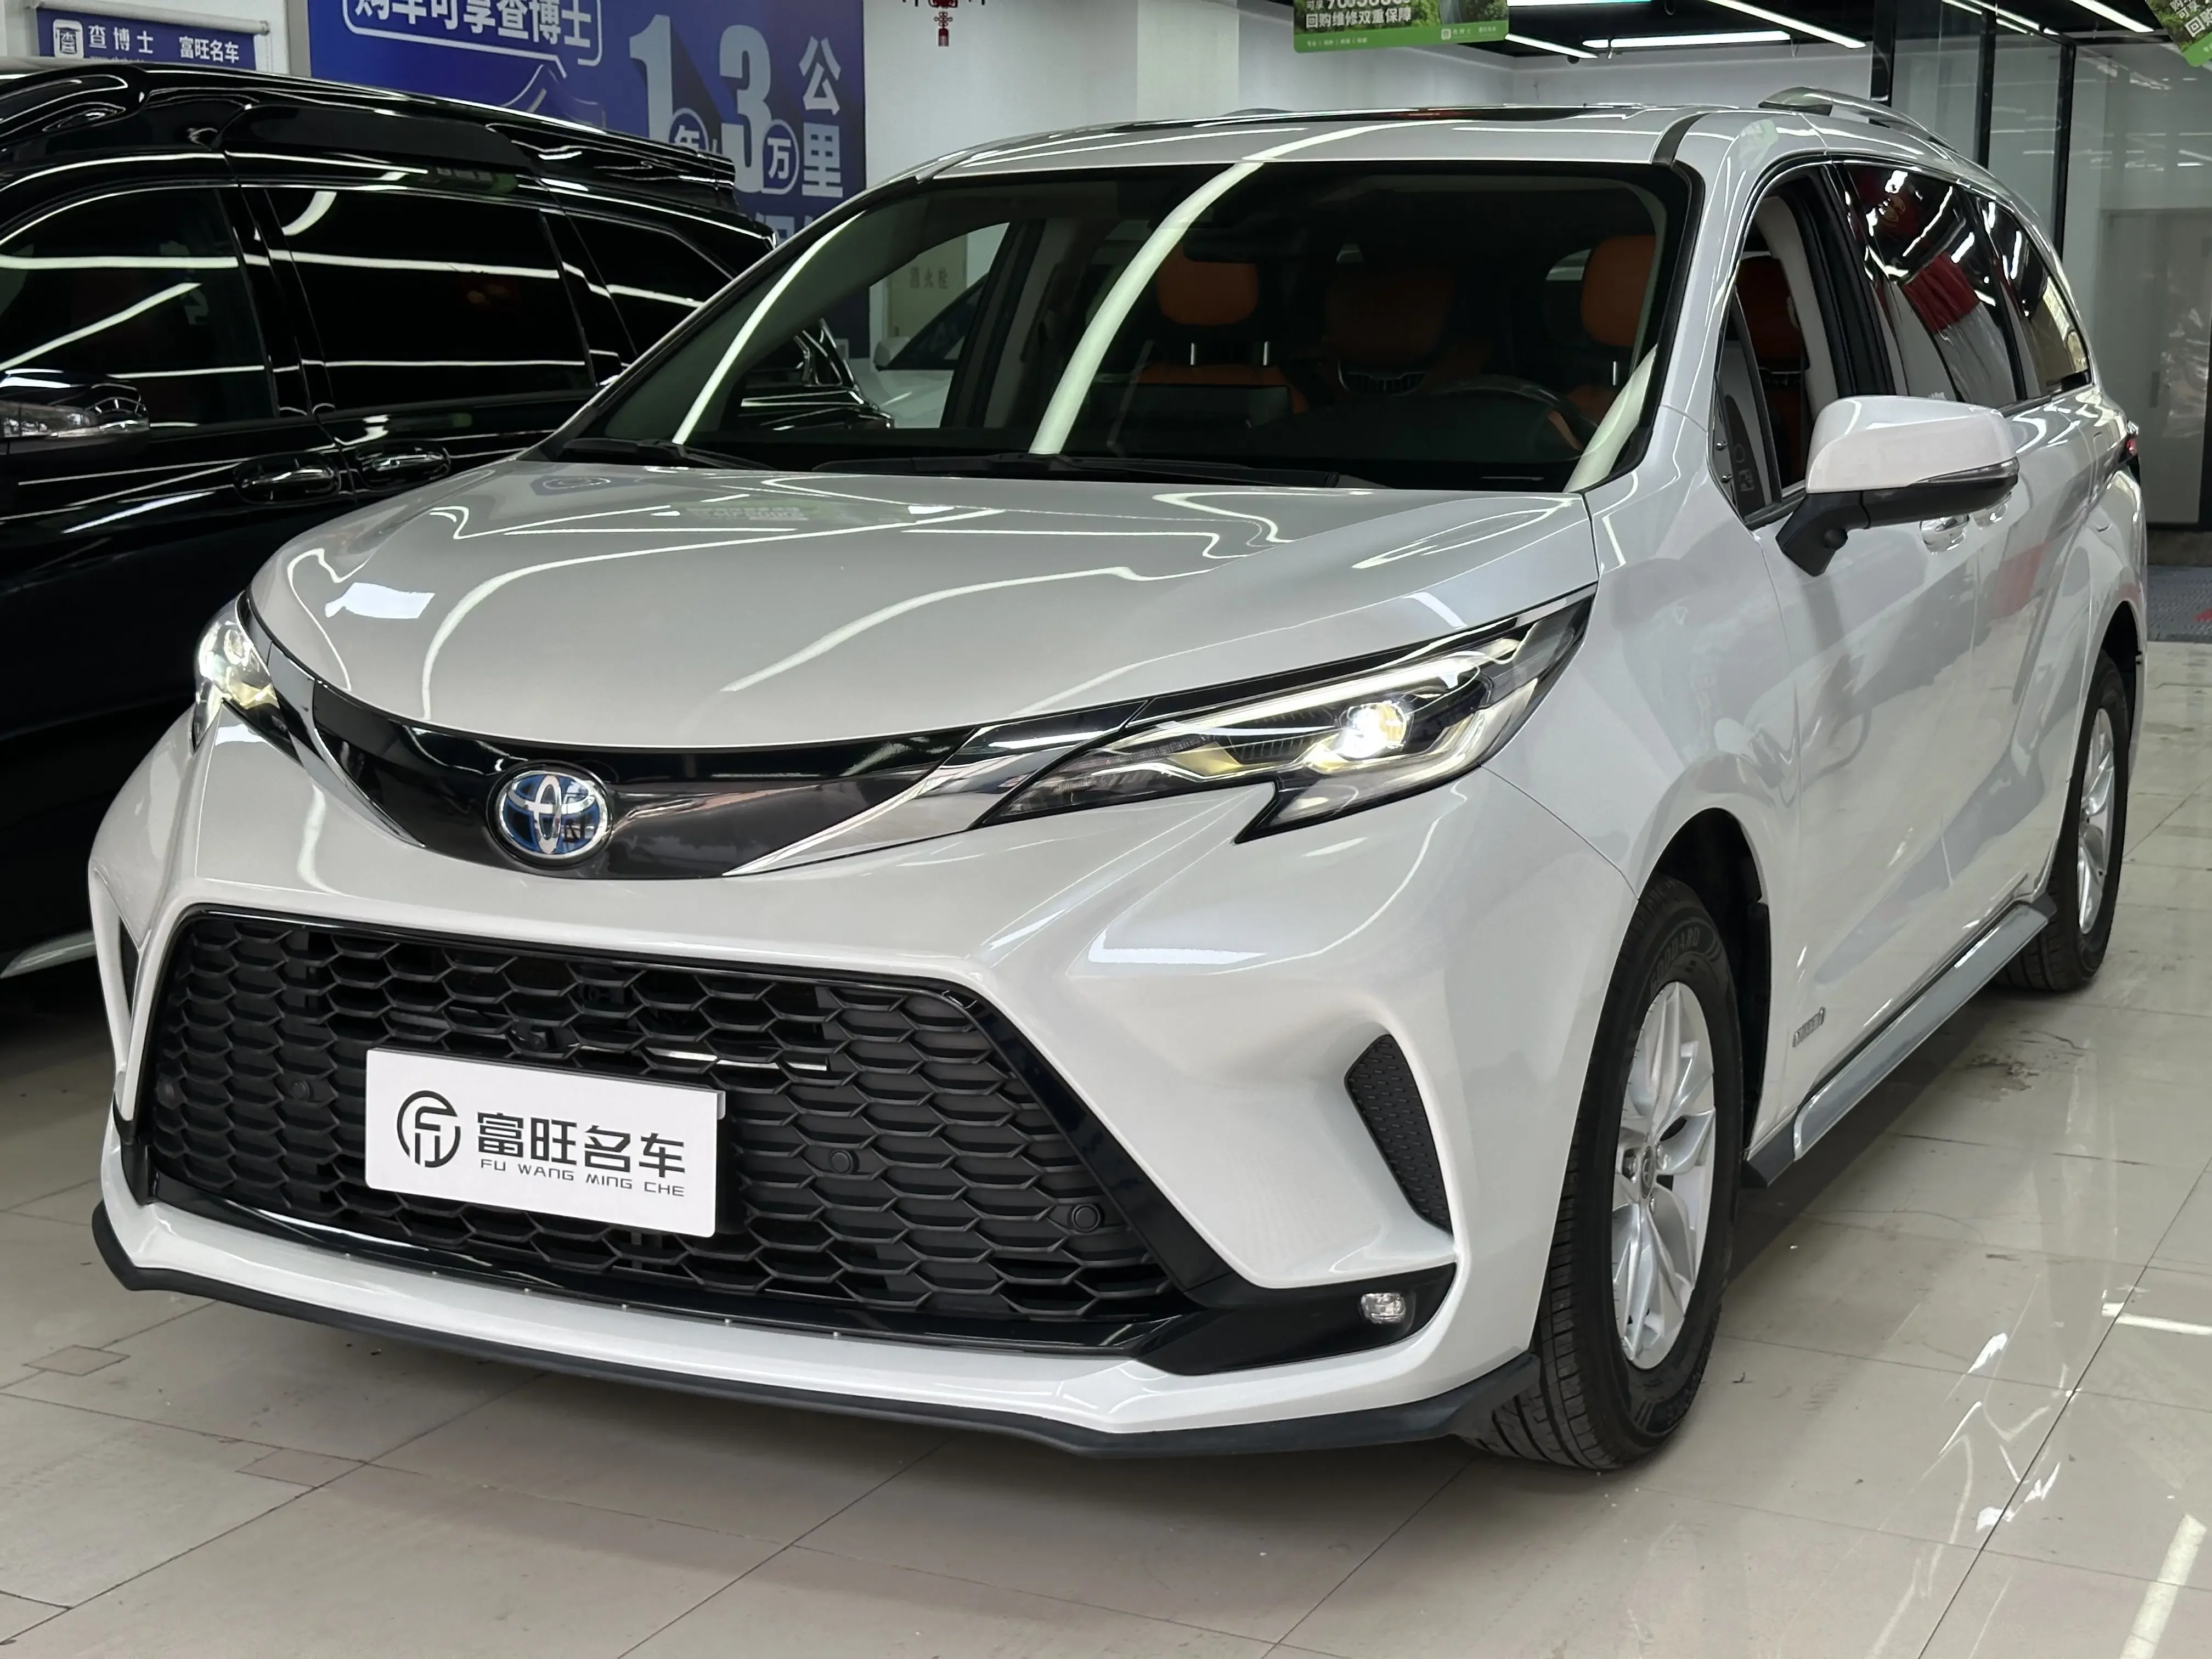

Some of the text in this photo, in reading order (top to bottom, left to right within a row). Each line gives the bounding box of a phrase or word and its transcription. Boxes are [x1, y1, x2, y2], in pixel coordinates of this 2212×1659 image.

[88, 24, 154, 54] 查博士
[178, 36, 240, 63] 富旺名车
[799, 36, 843, 198] 公里
[477, 1111, 686, 1178] 富旺名车
[481, 1158, 685, 1197] FU WANG MING CHE
